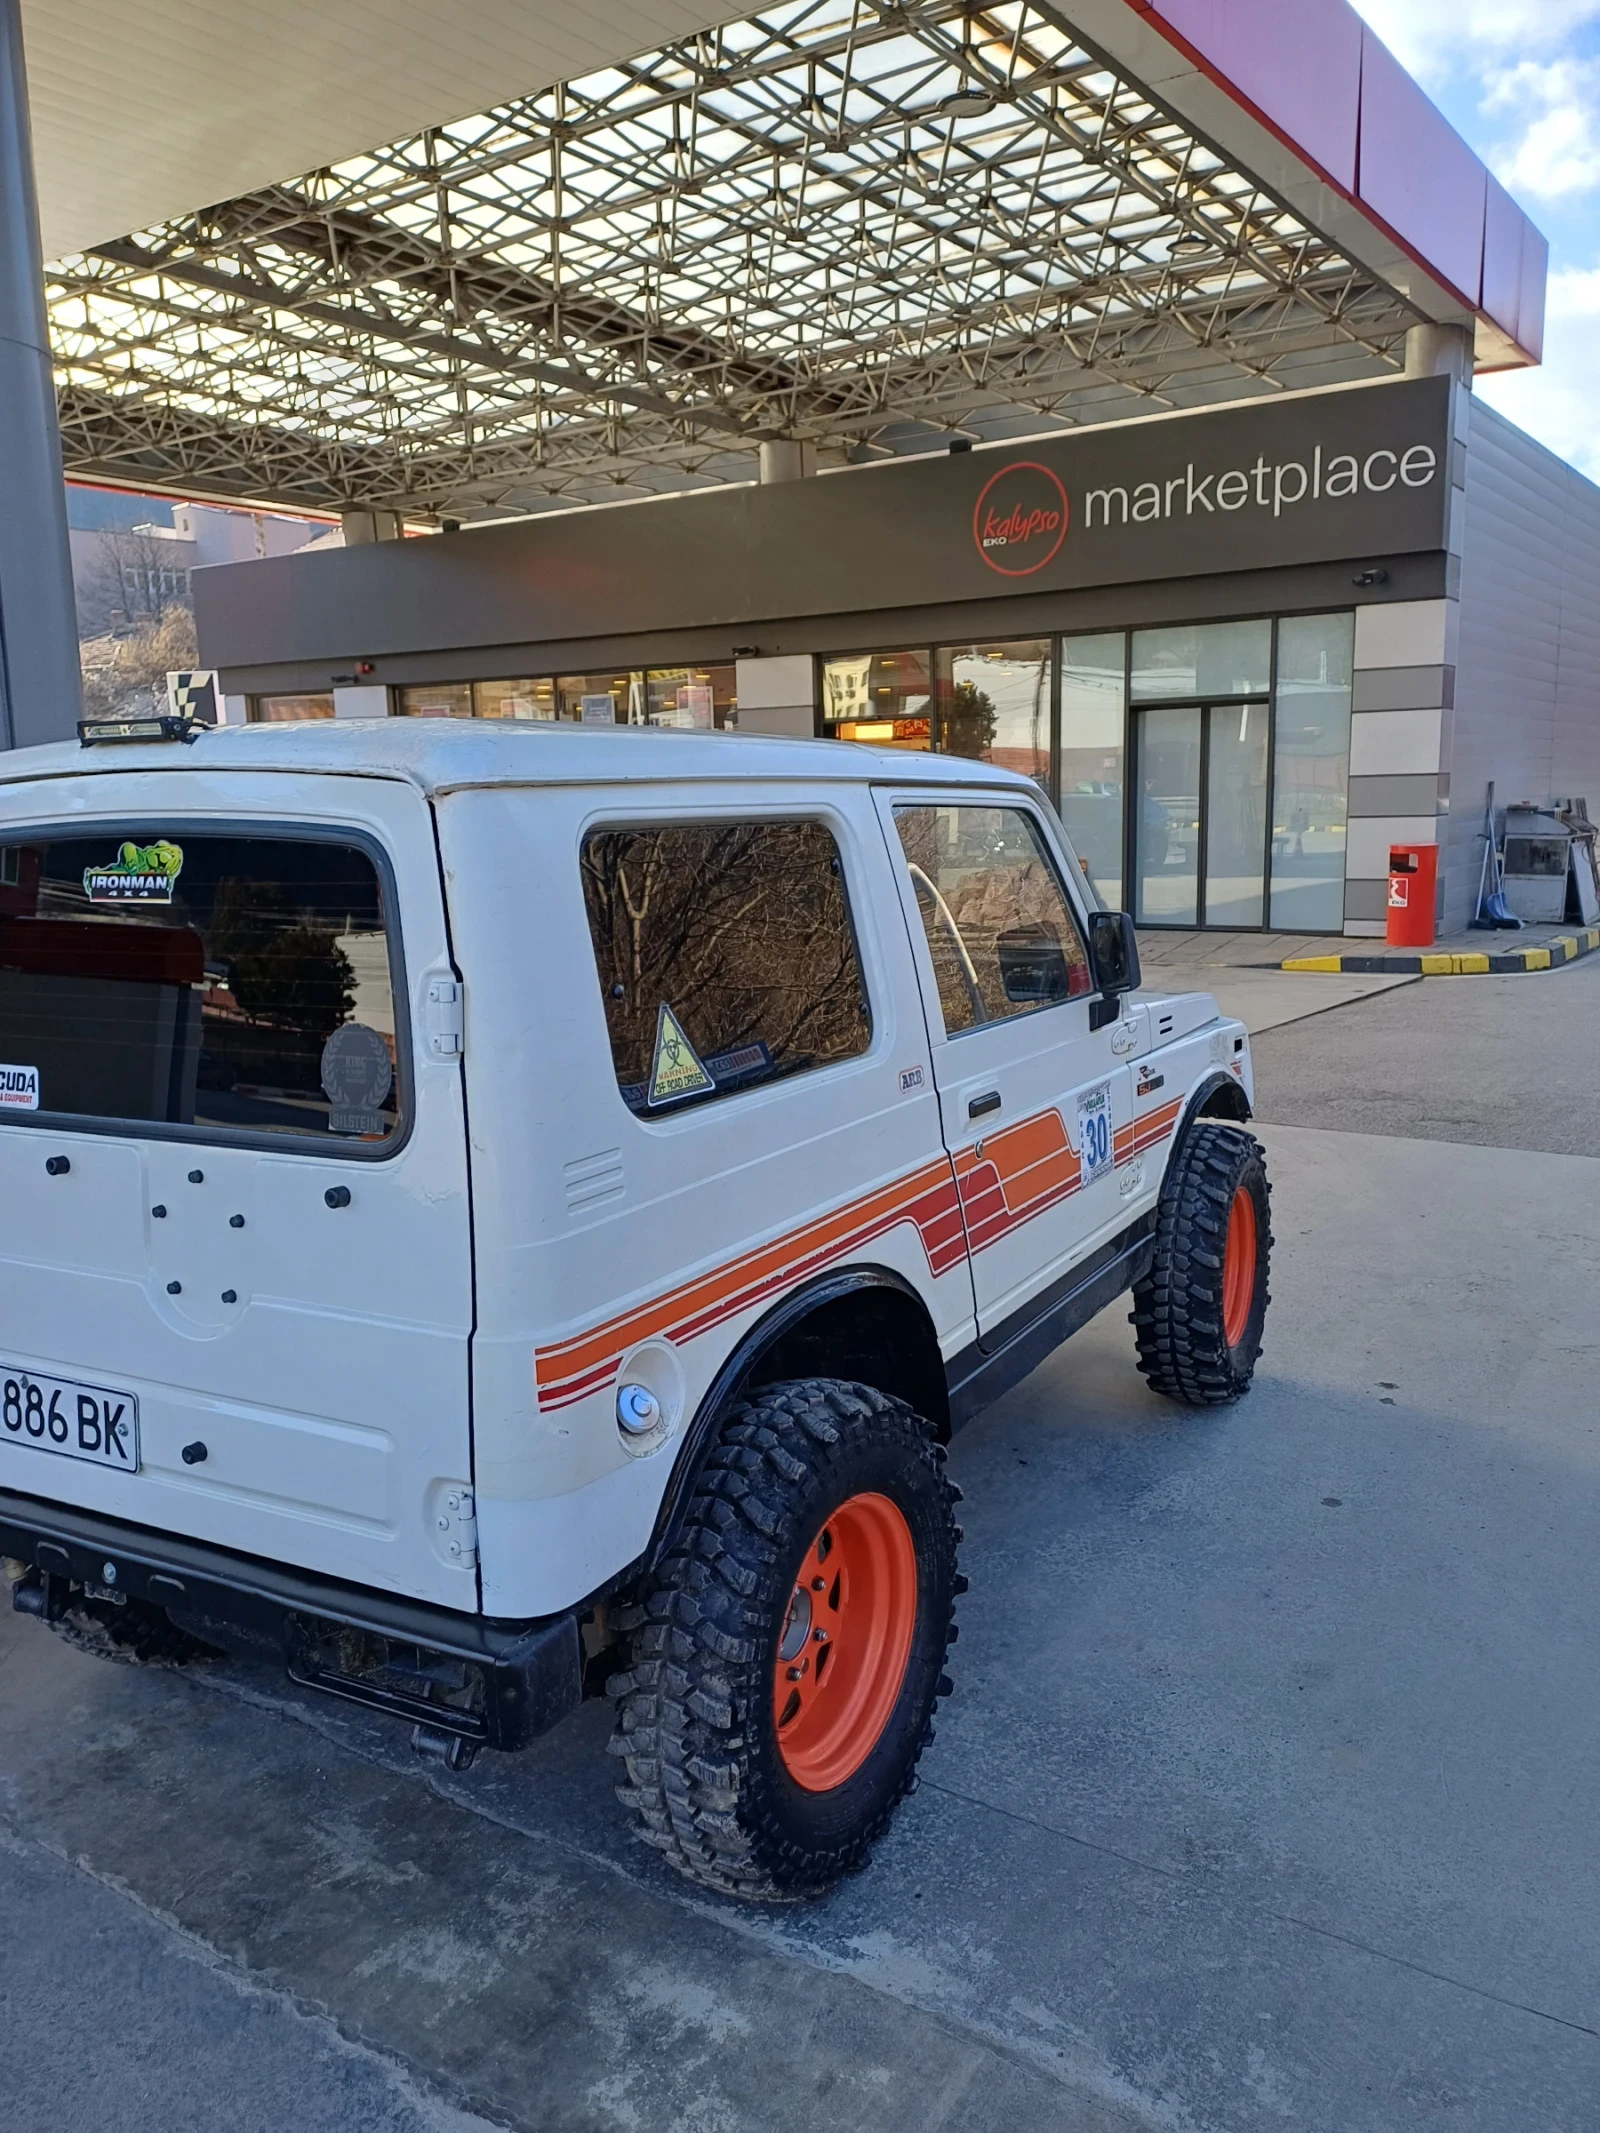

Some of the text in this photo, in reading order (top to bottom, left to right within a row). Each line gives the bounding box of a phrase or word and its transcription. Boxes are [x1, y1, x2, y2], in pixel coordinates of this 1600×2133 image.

[1085, 445, 1436, 527] marketplace
[983, 537, 1007, 547] EKO
[91, 875, 168, 889] IRONMAN
[658, 1064, 698, 1080] WARNING
[902, 1070, 922, 1089] ARB
[656, 1082, 666, 1093] OFF
[667, 1077, 684, 1090] ROAD
[685, 1073, 704, 1086] DRIVER
[1086, 1113, 1107, 1168] 30
[3, 1379, 128, 1460] 886 BK
